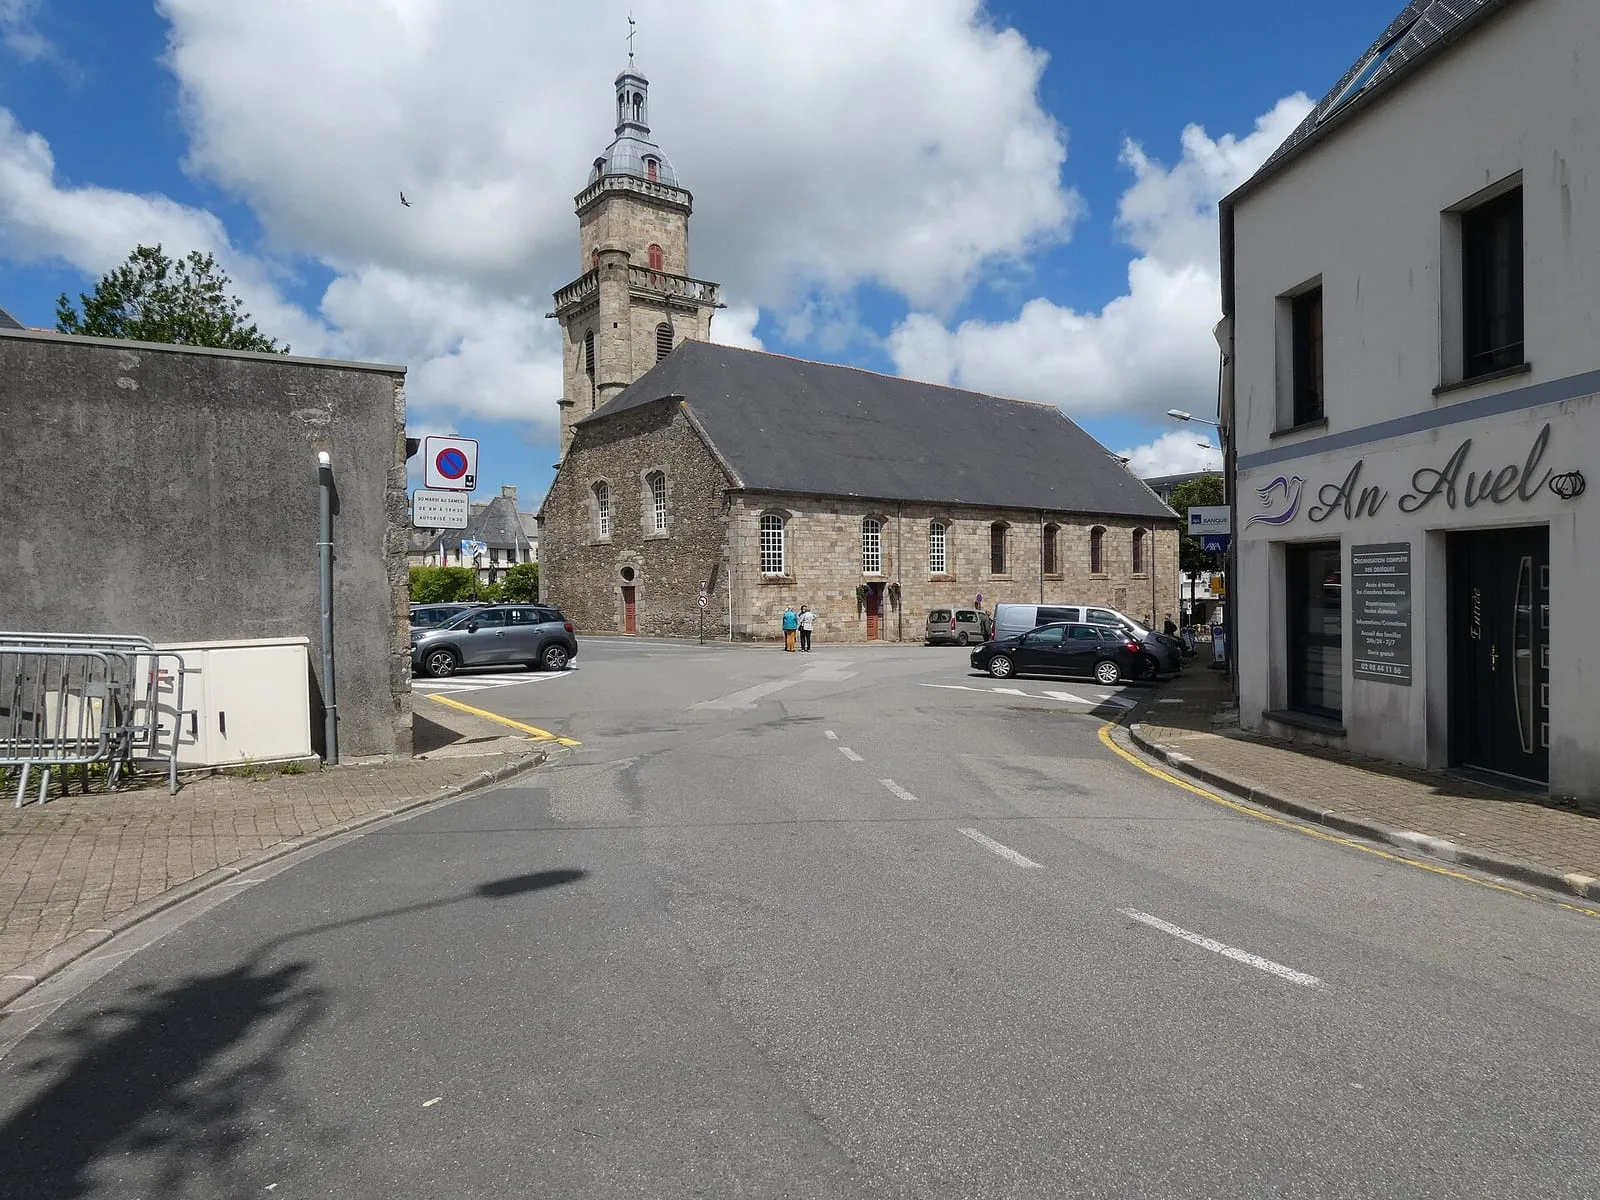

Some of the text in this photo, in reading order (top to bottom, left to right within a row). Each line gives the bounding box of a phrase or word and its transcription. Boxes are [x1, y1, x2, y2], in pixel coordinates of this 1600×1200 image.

[1307, 423, 1552, 523] An Avel
[1204, 542, 1221, 551] AXA
[1470, 588, 1480, 640] Entrée
